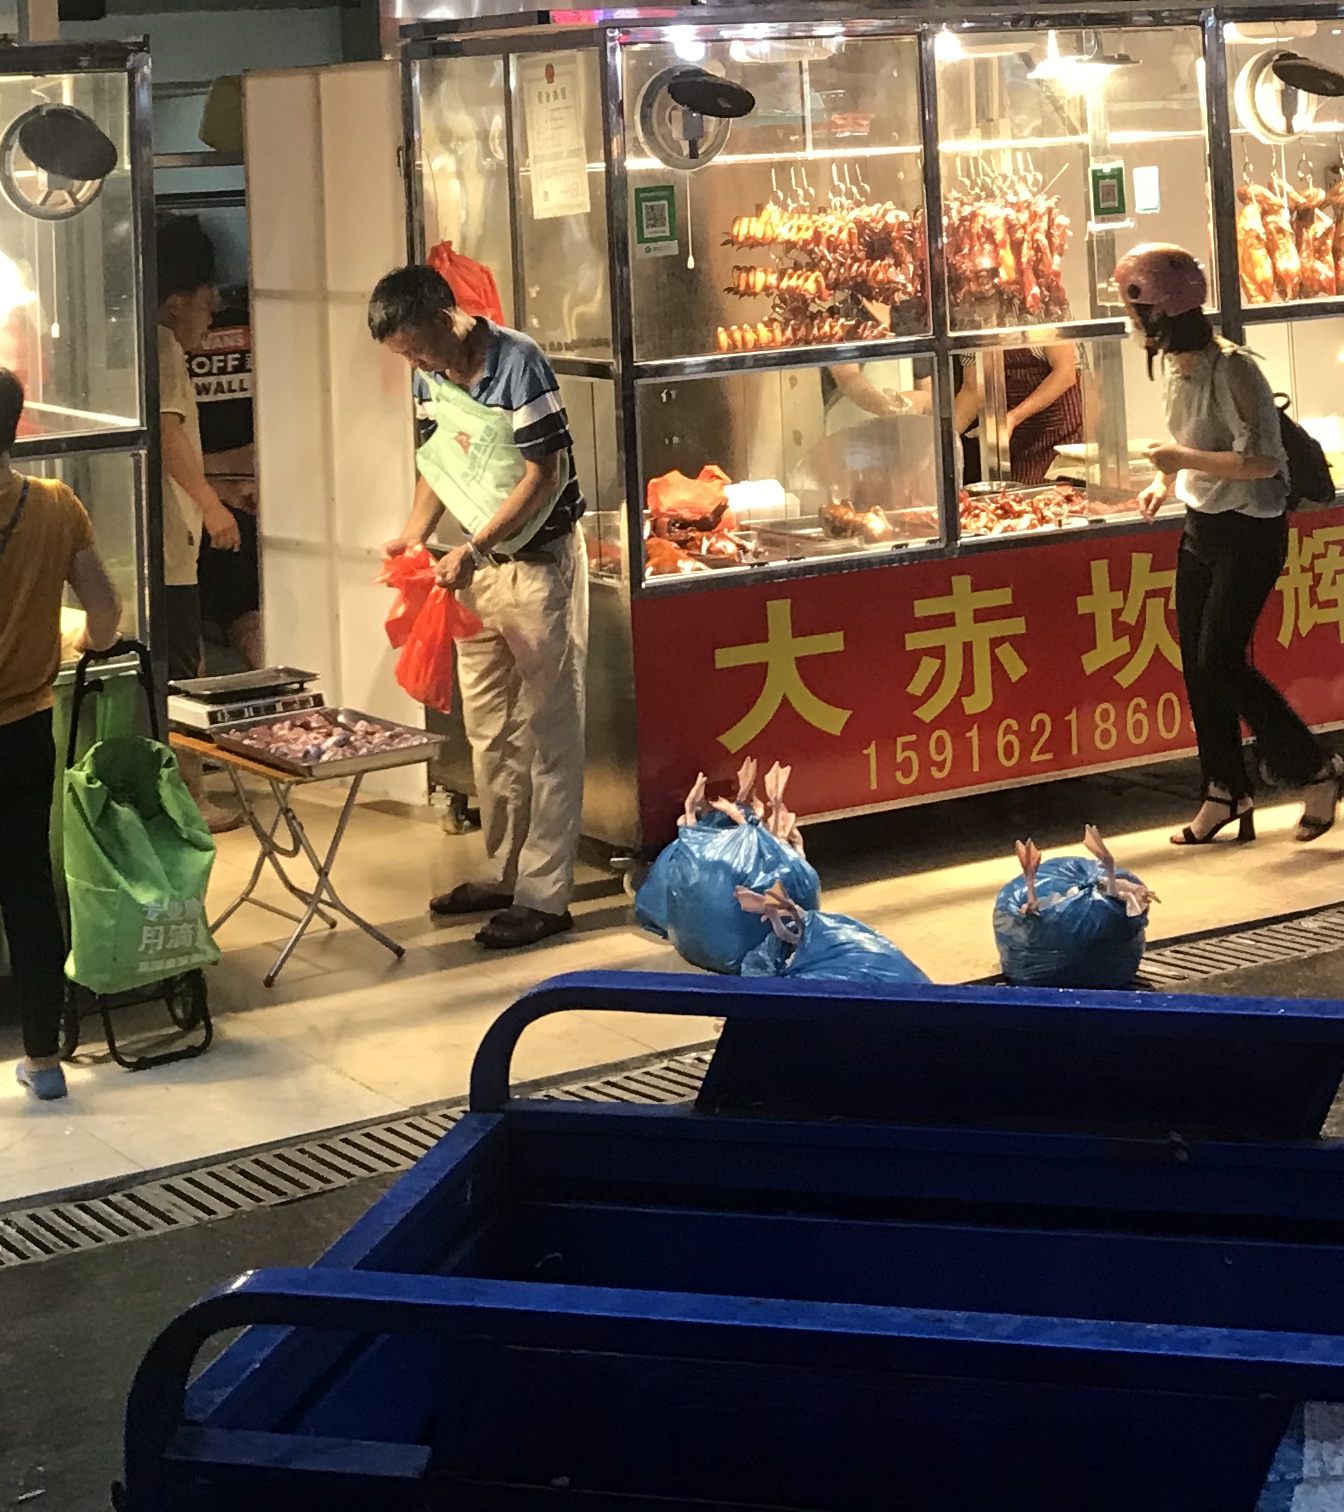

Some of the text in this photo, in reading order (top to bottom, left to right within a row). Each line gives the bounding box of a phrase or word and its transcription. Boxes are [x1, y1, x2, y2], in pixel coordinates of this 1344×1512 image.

[192, 353, 241, 374] OFF
[194, 379, 249, 396] WALL
[862, 691, 1197, 791] 1591621860
